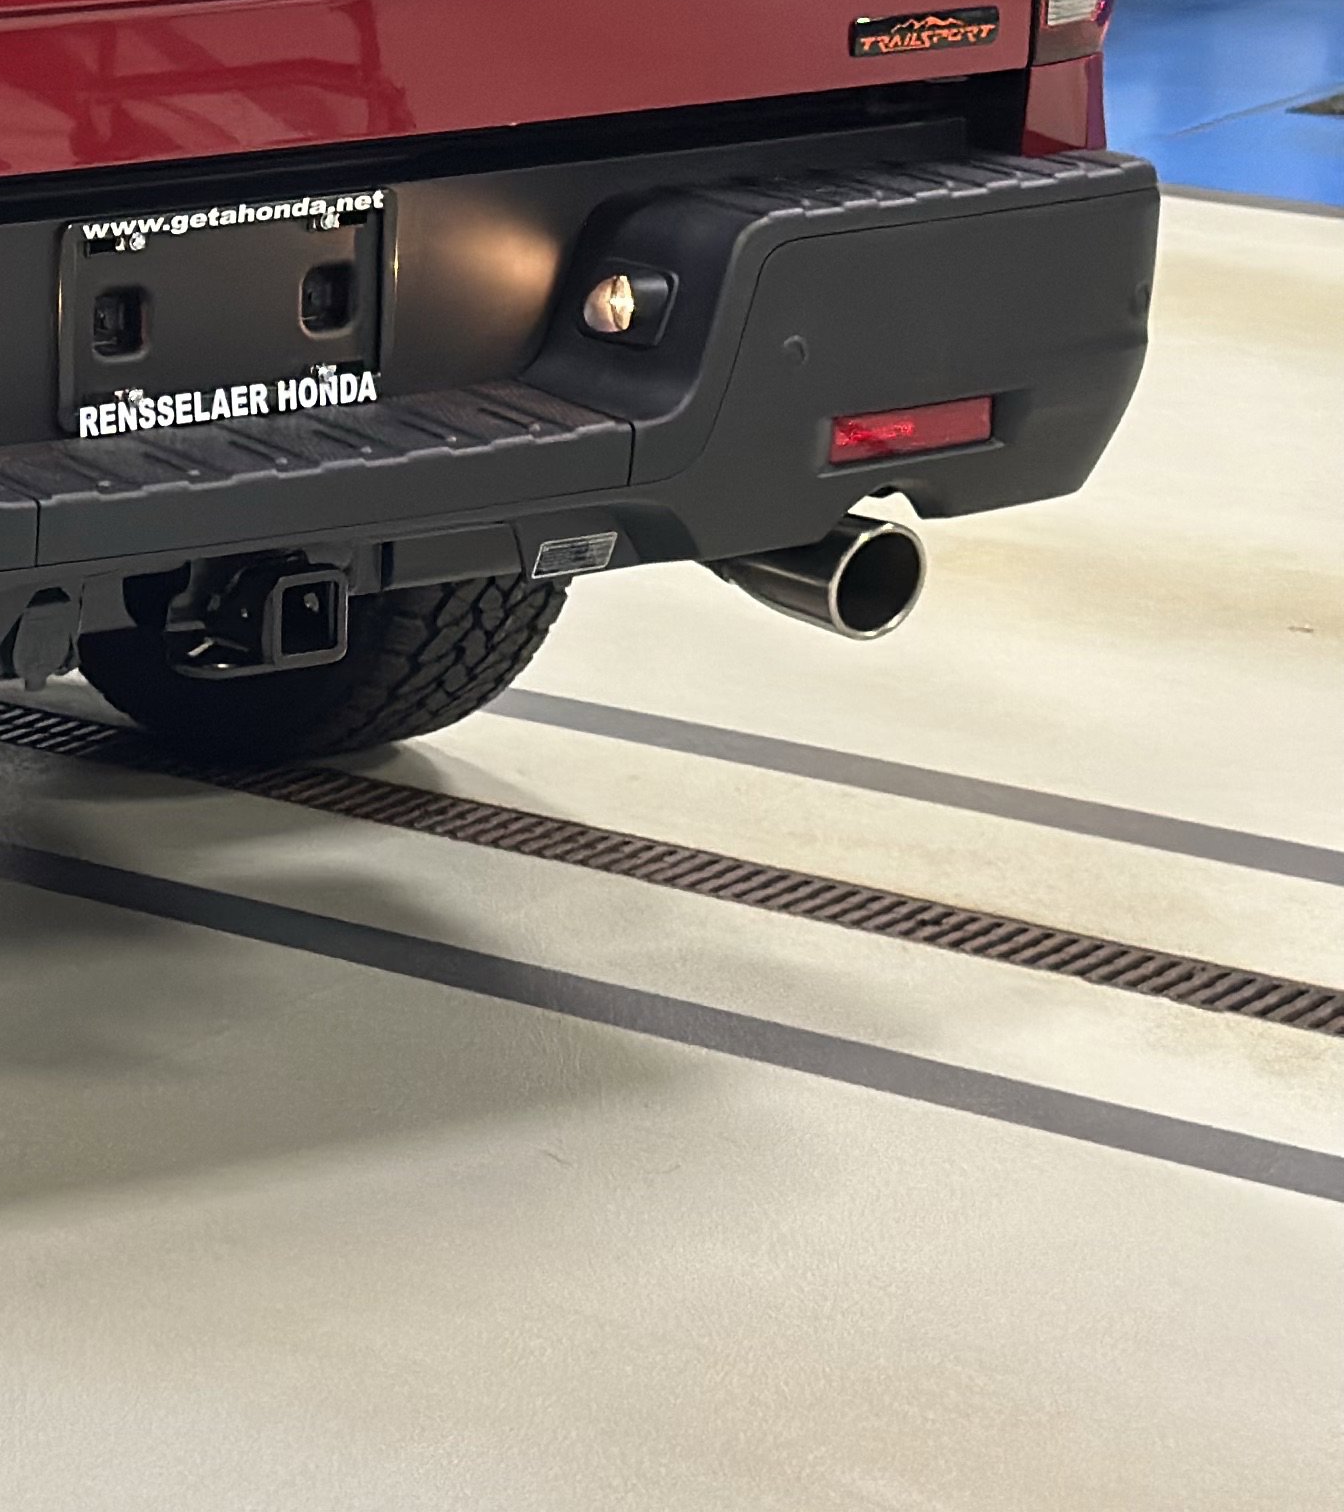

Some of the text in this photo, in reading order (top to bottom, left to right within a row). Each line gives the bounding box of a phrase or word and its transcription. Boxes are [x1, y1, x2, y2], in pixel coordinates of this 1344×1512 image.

[860, 24, 996, 53] TRAILSPORT
[82, 189, 385, 240] www.getahonda.net
[78, 371, 377, 438] RENSSELAER HONDA
